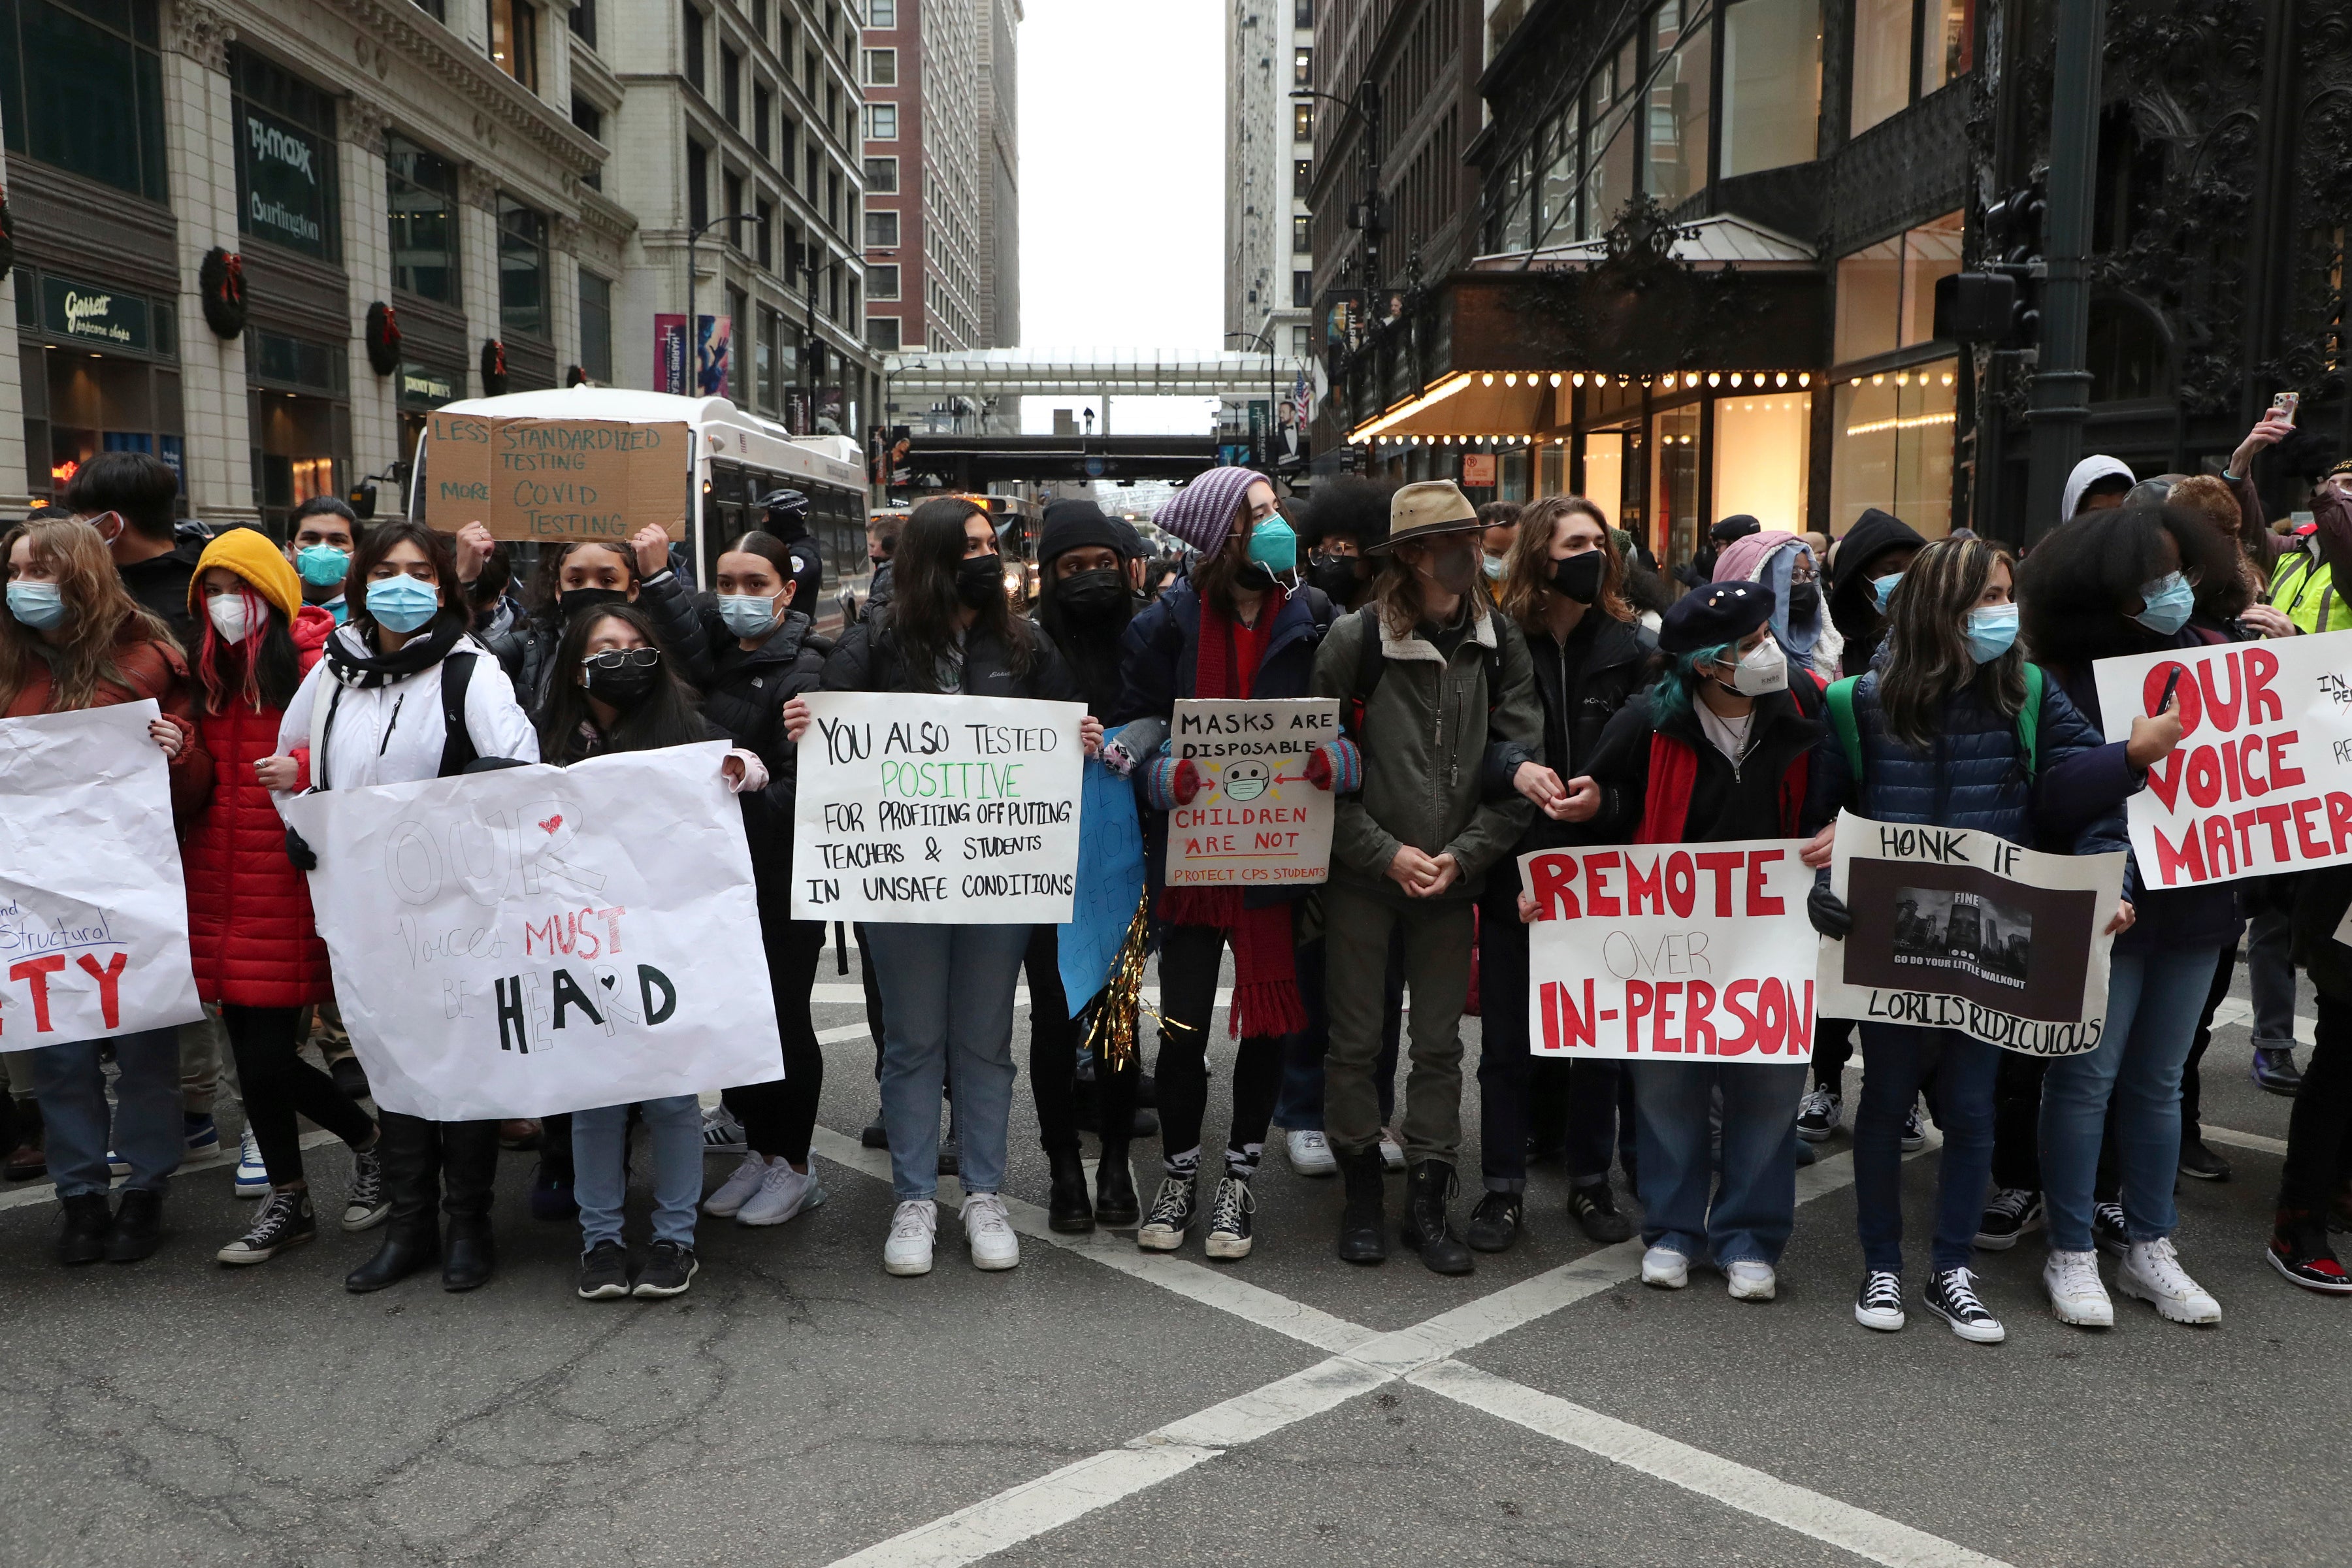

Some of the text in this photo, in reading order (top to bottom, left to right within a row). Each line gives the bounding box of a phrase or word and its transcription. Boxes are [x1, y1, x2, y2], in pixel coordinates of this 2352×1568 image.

[252, 191, 319, 240] Burlington
[65, 291, 111, 333] Garrett
[76, 319, 131, 342] popcorn shops
[435, 420, 661, 451] LESS STANDARDIZED
[500, 453, 586, 470] TESTING
[440, 480, 597, 506] MORE COVID
[523, 510, 627, 535] TESTING
[1761, 676, 1780, 684] KN95
[2143, 647, 2283, 741] OUR
[2317, 674, 2345, 693] IN
[1181, 713, 1333, 734] MASKS ARE
[817, 717, 1057, 766] YOU ALSO TESTED
[1183, 740, 1316, 760] DISPOSABLE
[881, 760, 1024, 800] POSITIVE
[2146, 730, 2306, 816] VOICE
[824, 800, 1072, 834] FOR PROFITING OFF PUTTING
[1175, 807, 1307, 828] CHILDREN
[385, 800, 608, 907] OUR
[815, 835, 1041, 870] TEACHERS & STUDENTS
[1185, 832, 1300, 855] ARE NOT
[1880, 826, 2022, 877] HONK IF
[806, 873, 1073, 904] IN UNSAFE CONDITIONS
[1175, 867, 1326, 882] PROTECT CPS STUDENTS
[1529, 849, 1786, 922] REMOTE
[1954, 892, 1980, 907] FINE
[0, 907, 111, 951] Structural
[392, 906, 626, 970] Voices MUST
[1603, 930, 1712, 979] OVER
[1894, 955, 1908, 964] GO
[1925, 957, 1952, 968] YOUR
[1953, 960, 1980, 977] LITTLE
[1981, 969, 2026, 990] WALKOUT
[443, 964, 677, 1054] BE HEARD
[1539, 976, 1814, 1056] IN-PERSON
[1868, 989, 2101, 1055] LORI IS RIDICULOUS
